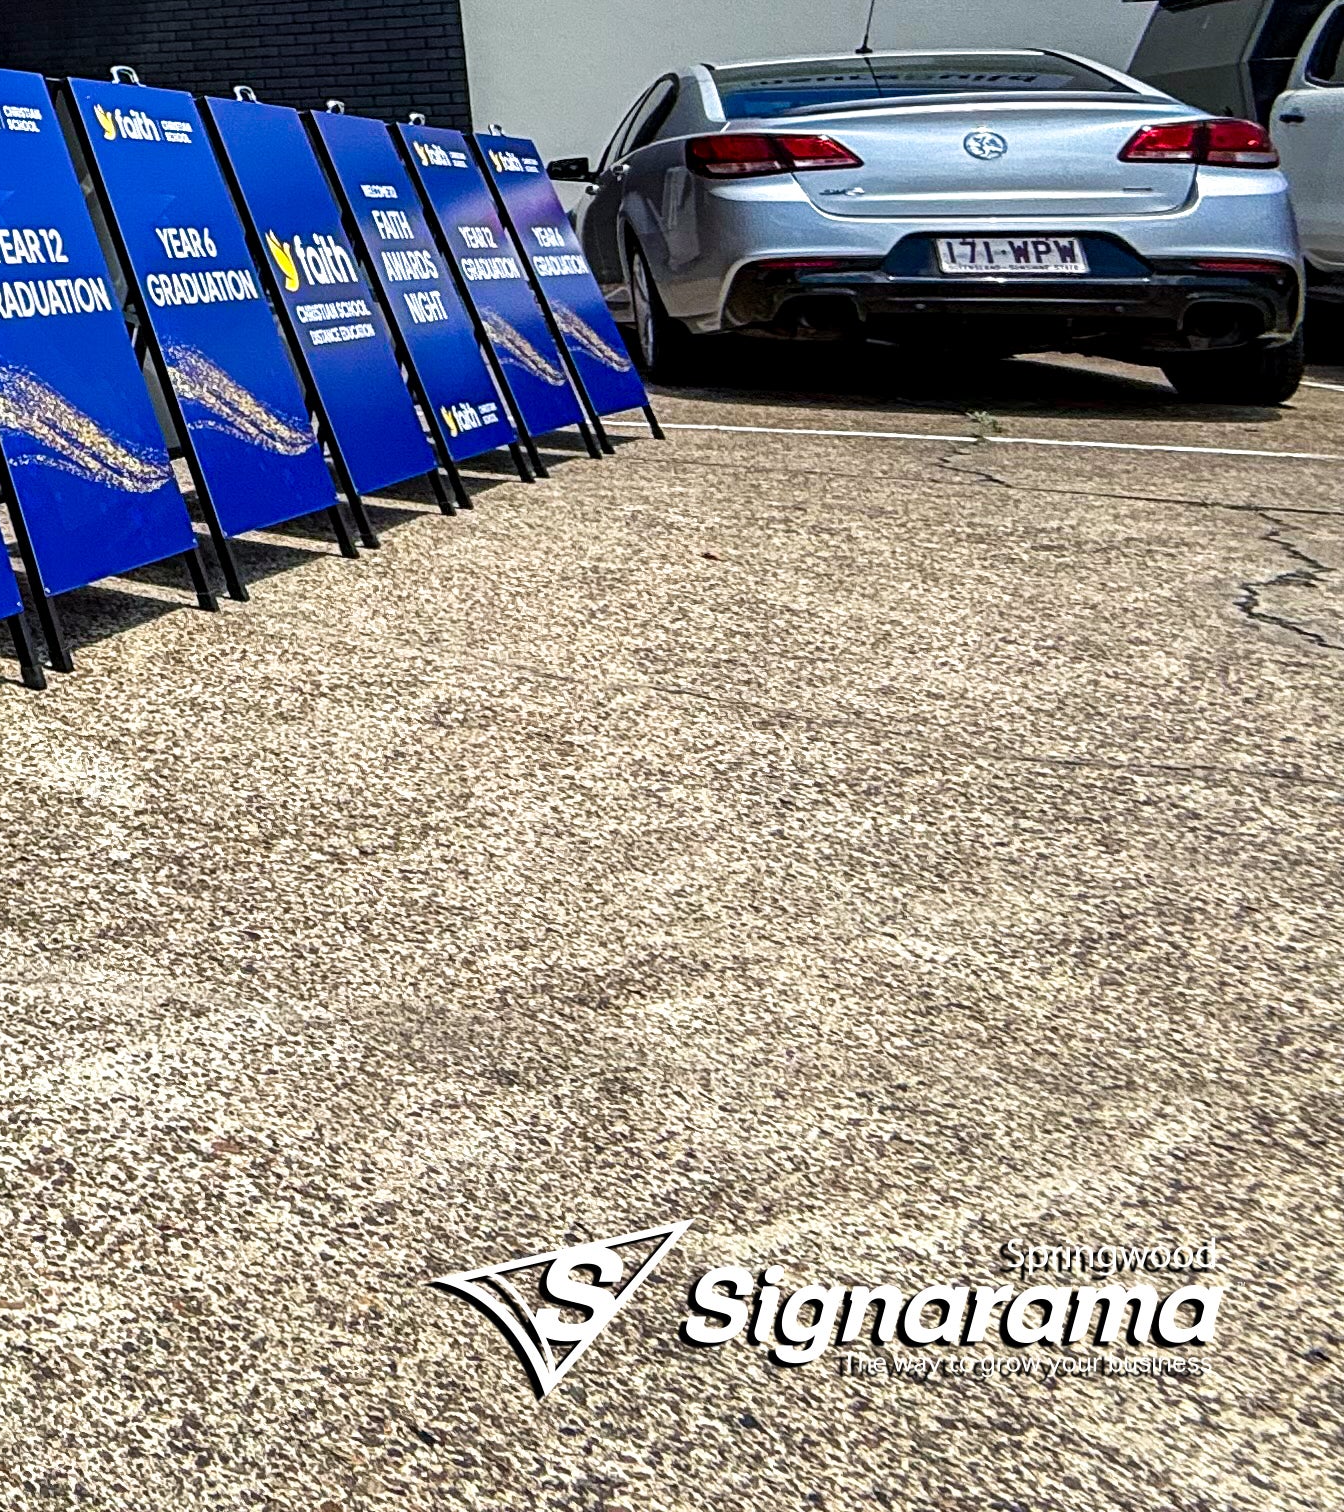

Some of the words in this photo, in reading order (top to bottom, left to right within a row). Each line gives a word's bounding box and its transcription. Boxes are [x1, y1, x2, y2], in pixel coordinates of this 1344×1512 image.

[114, 108, 161, 141] faith
[371, 210, 415, 240] FAITH
[41, 228, 69, 263] 12
[155, 228, 207, 259] YEAR
[203, 227, 218, 257] 6
[293, 233, 359, 285] faith
[381, 249, 439, 282] AWARDS
[461, 257, 520, 281] GRADUATION
[532, 255, 589, 277] GRADUATION
[146, 269, 259, 307] GRADUATION
[404, 290, 448, 324] NIGHT
